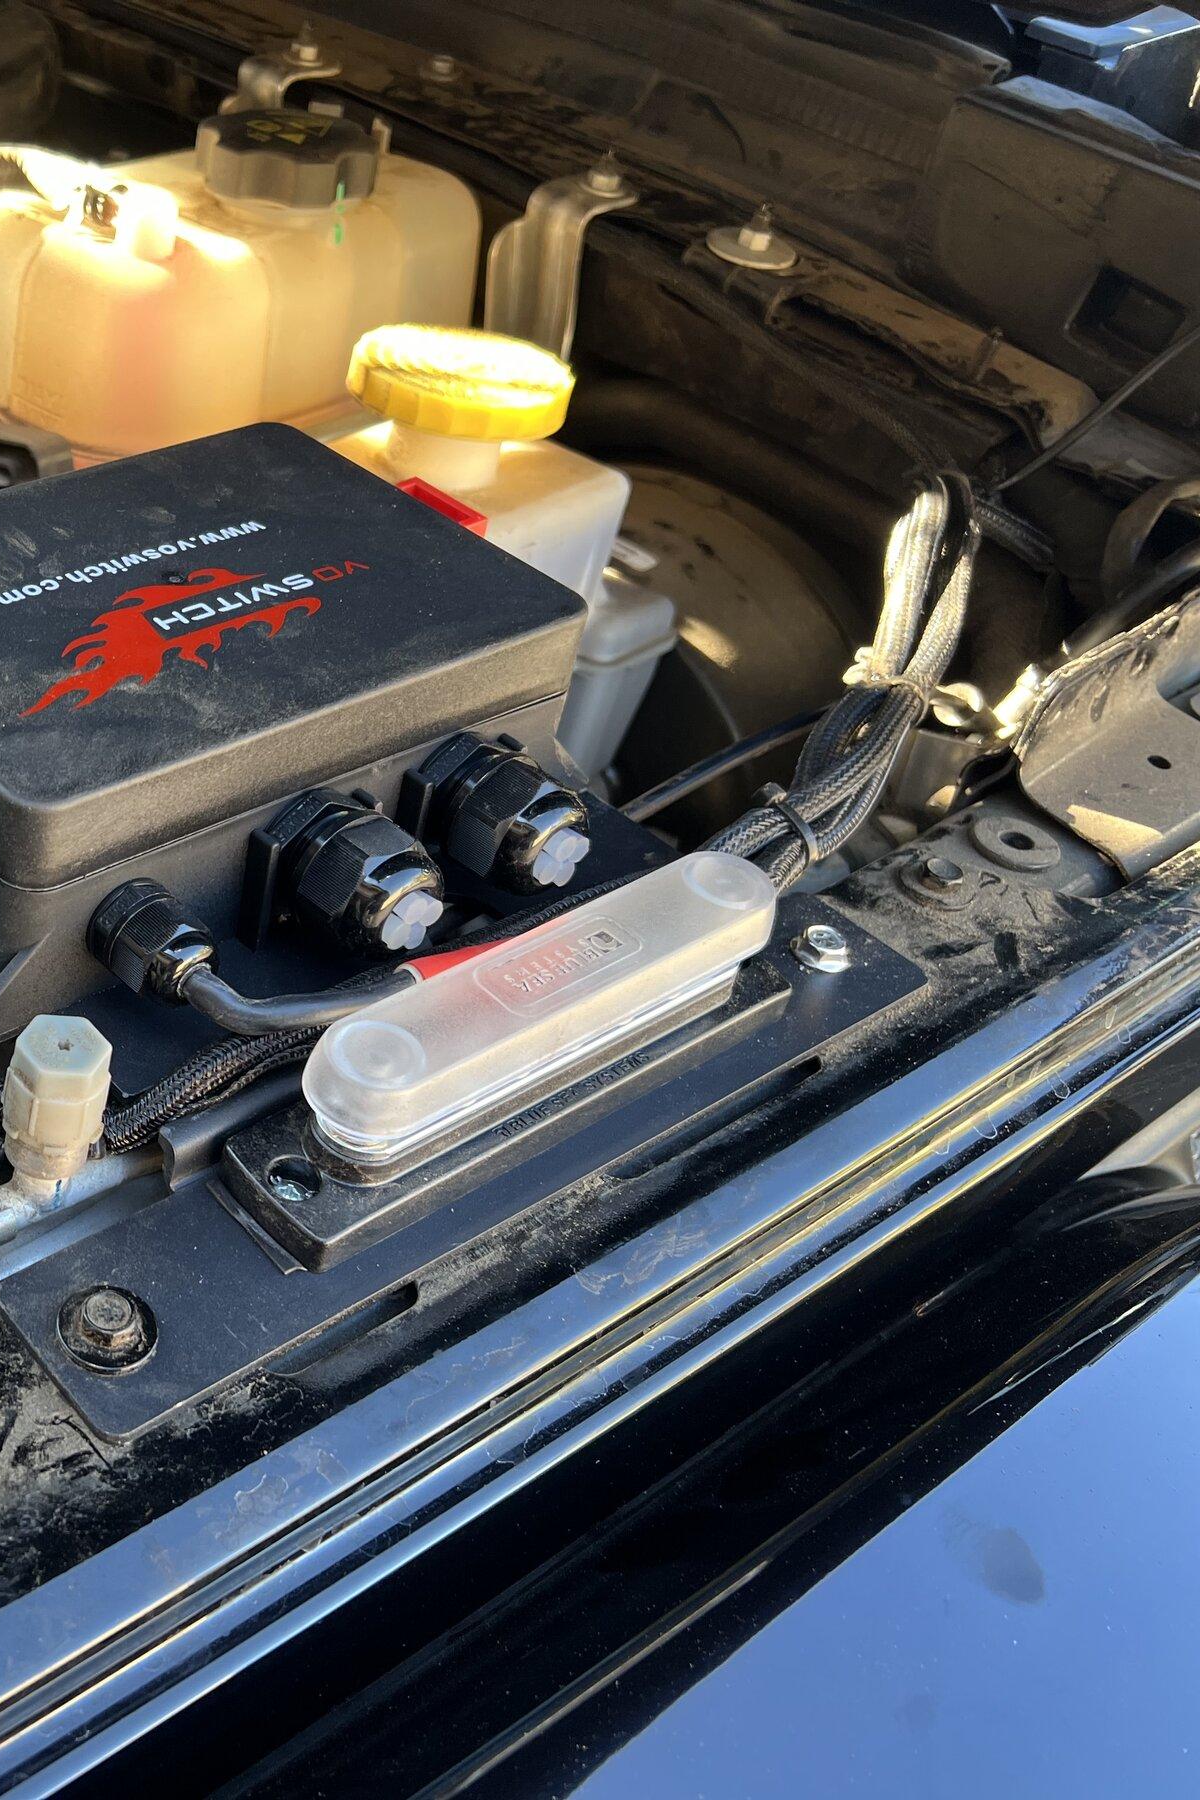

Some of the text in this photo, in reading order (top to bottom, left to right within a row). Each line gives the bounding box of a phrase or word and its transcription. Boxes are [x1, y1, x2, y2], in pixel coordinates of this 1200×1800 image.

[503, 938, 588, 986] SYSTEMS
[506, 1051, 650, 1132] BLUE SEA SYSTEMS
